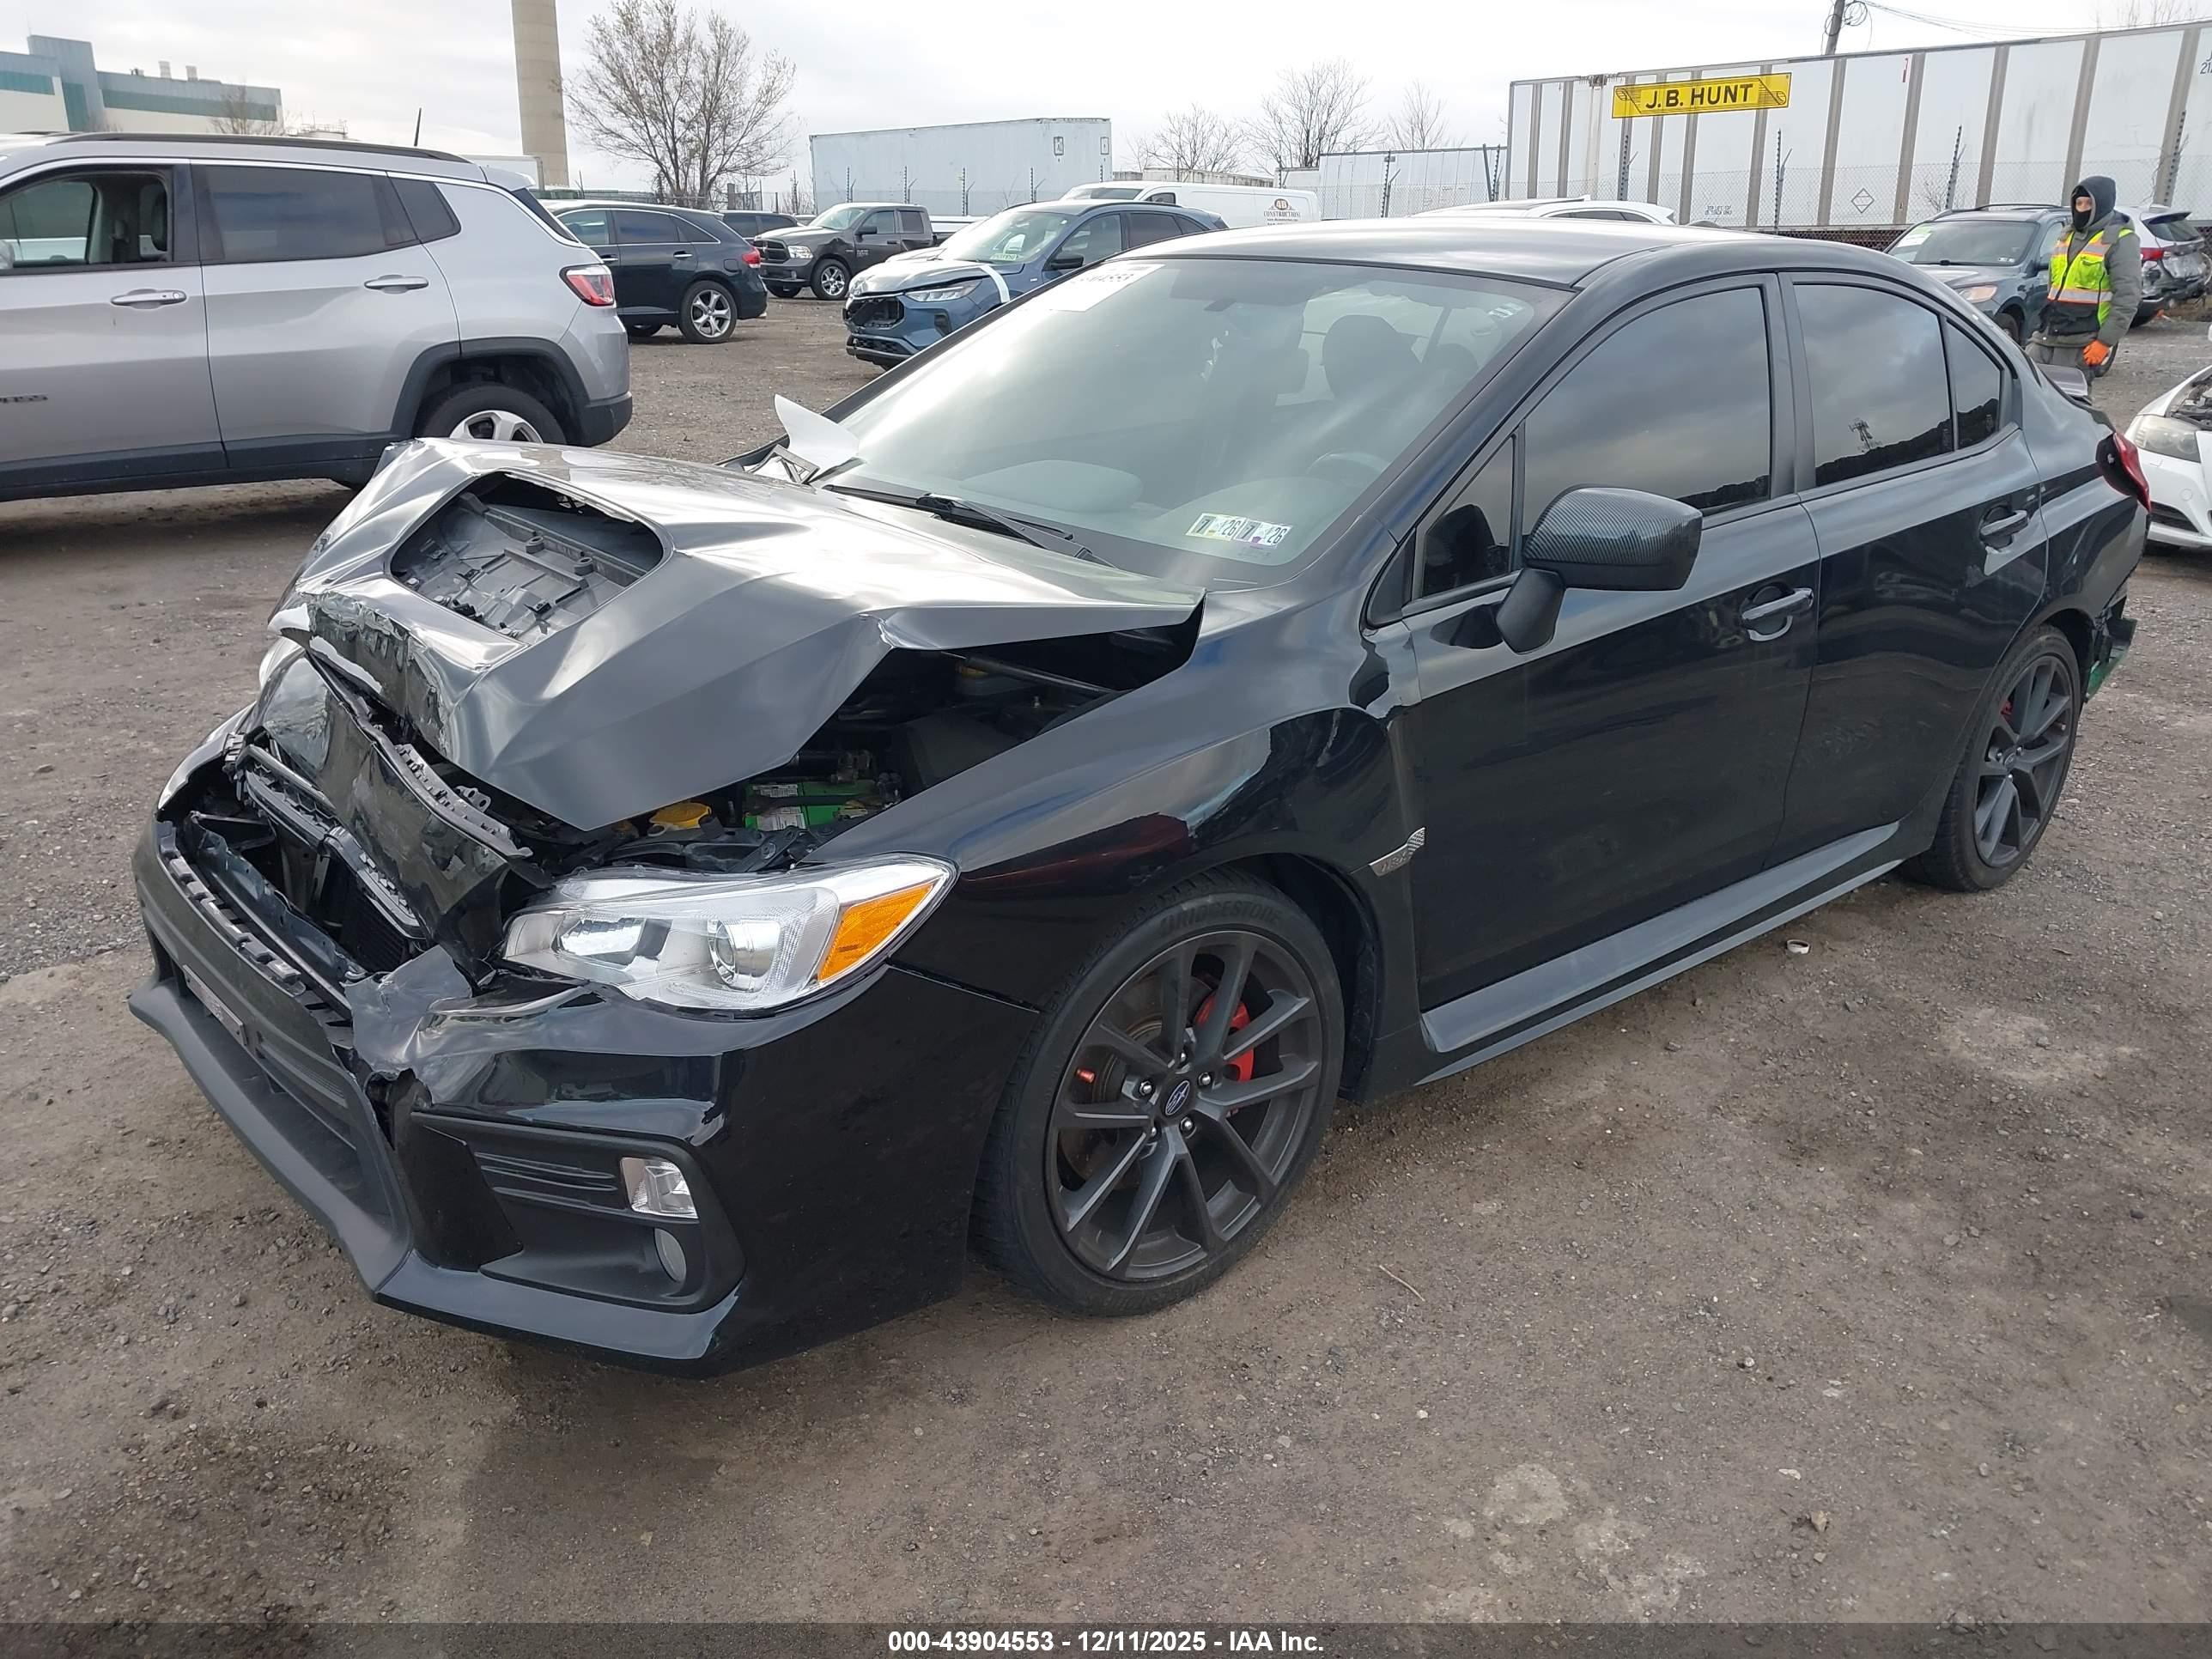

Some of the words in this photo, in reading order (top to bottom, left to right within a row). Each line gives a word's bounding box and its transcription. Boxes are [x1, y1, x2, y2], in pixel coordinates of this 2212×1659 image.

[1690, 83, 1753, 106] HUNT
[1221, 520, 1242, 537] 26
[1267, 527, 1287, 544] 26
